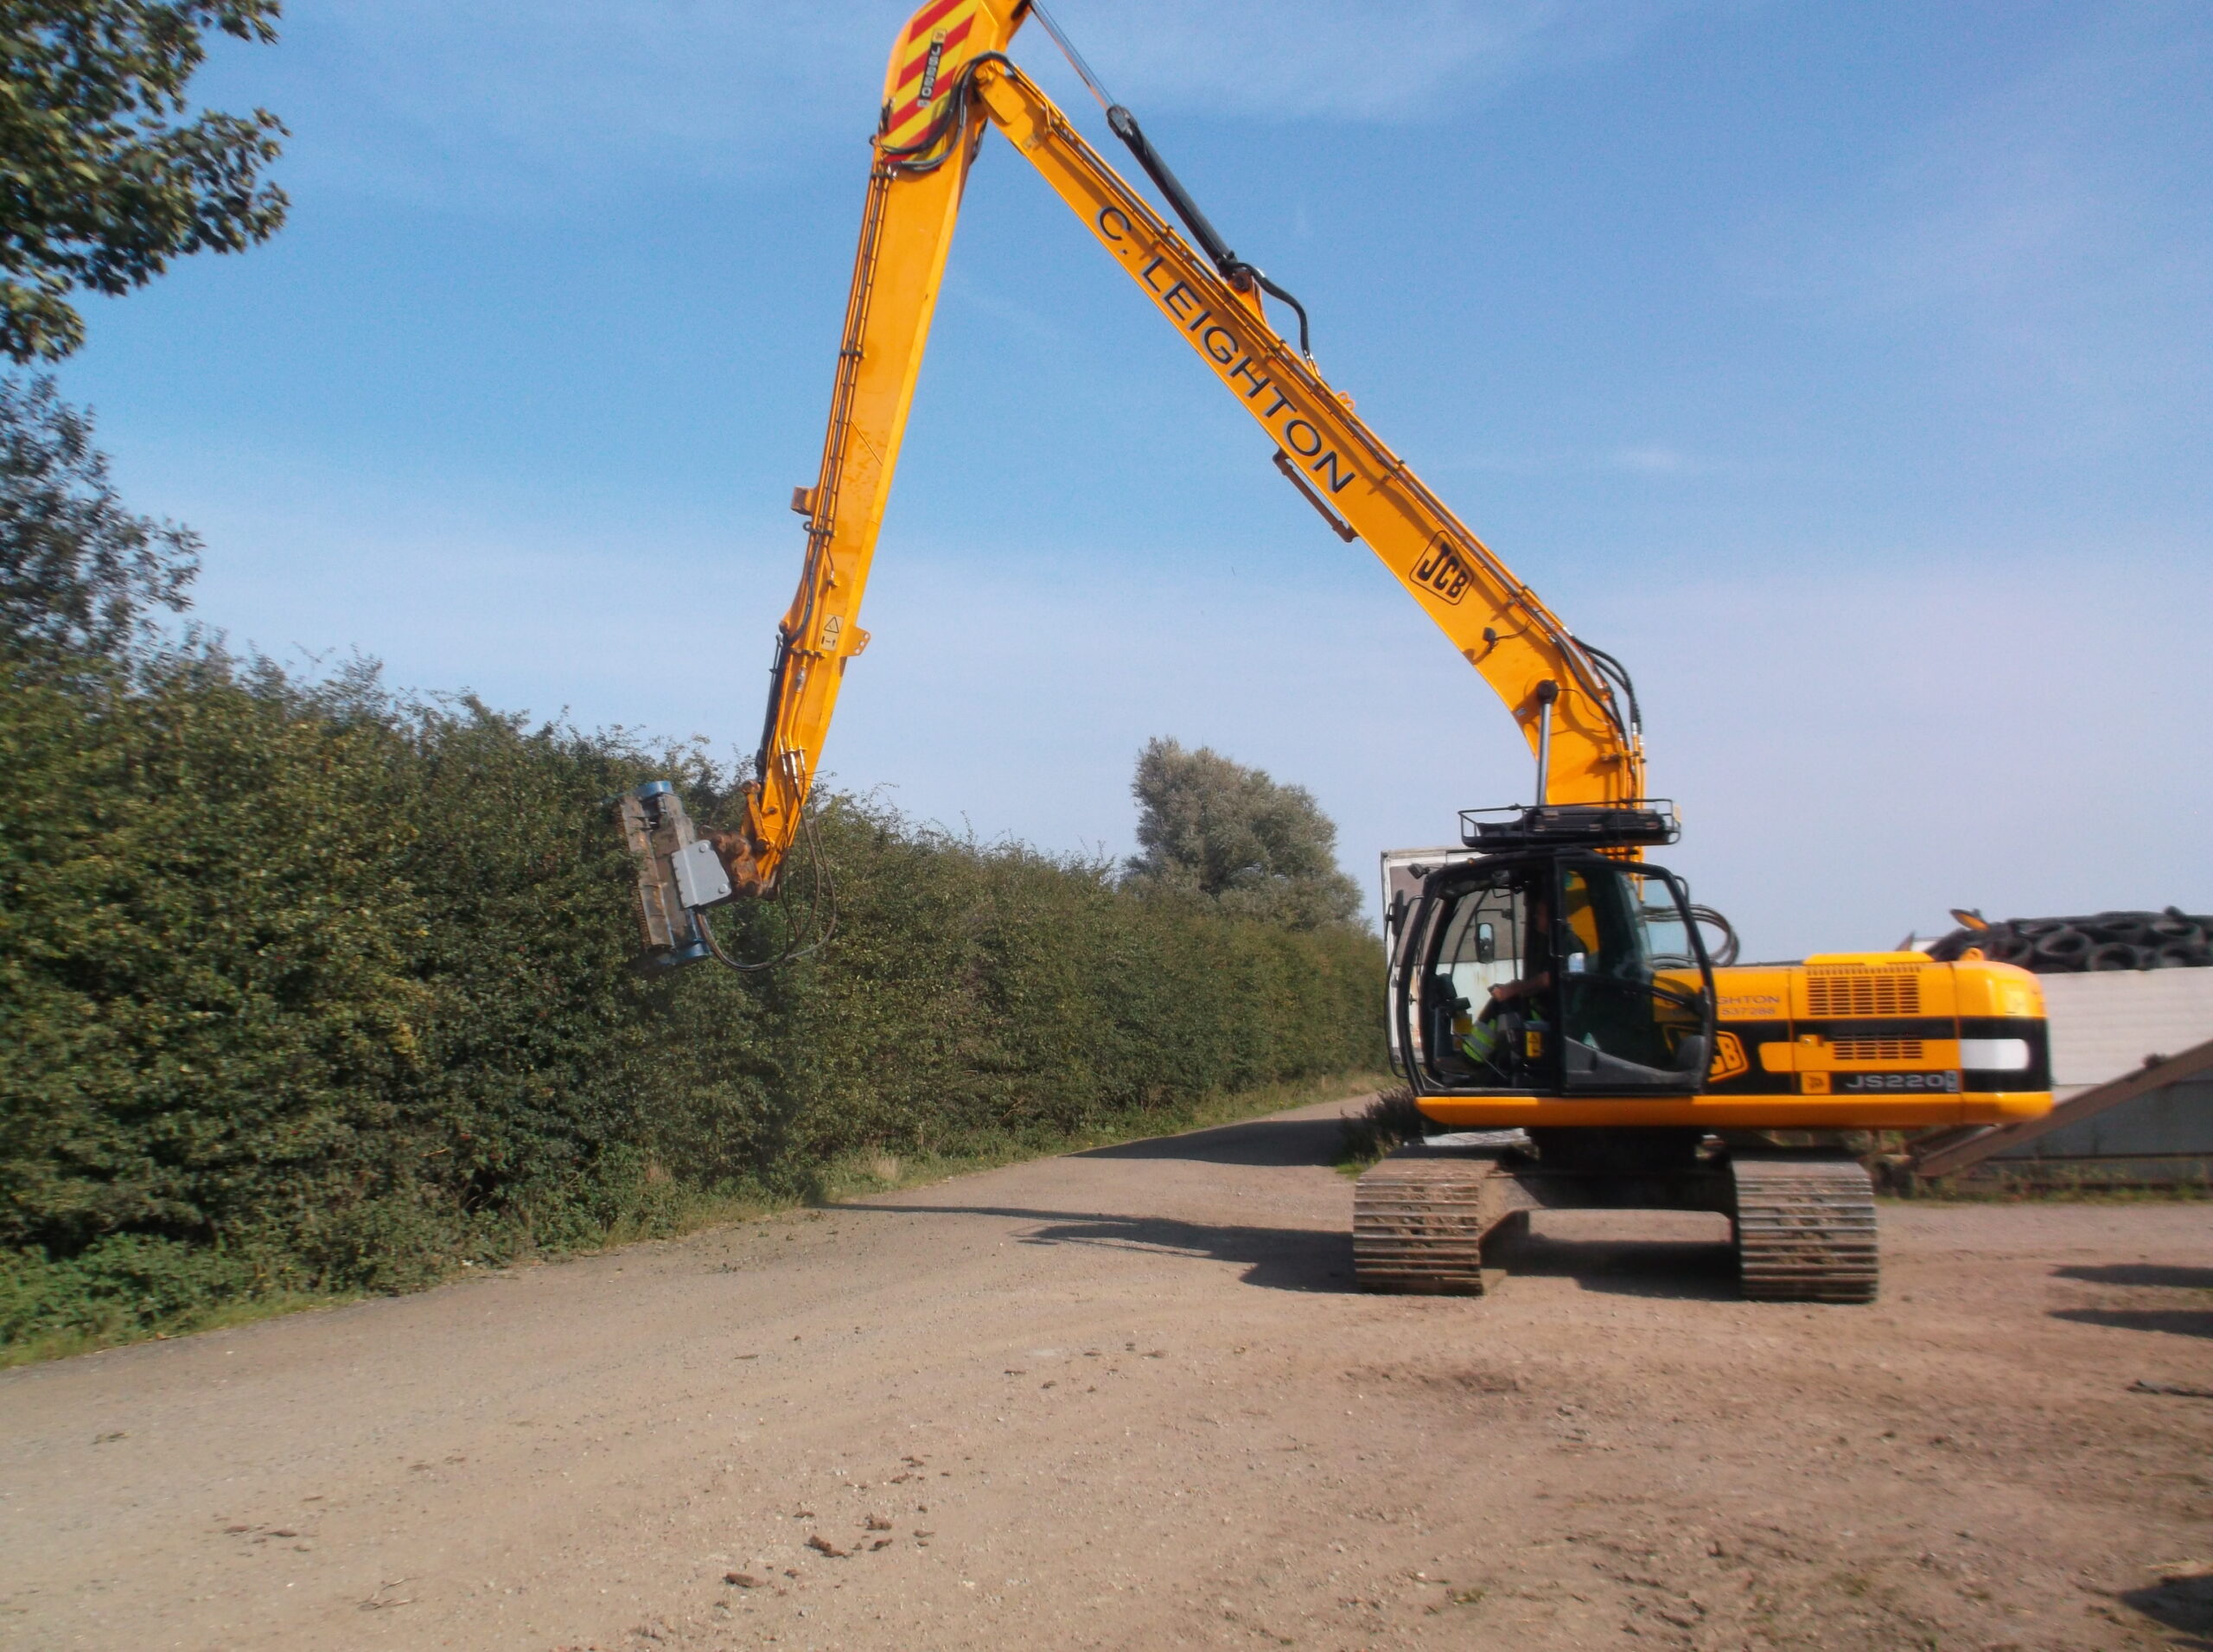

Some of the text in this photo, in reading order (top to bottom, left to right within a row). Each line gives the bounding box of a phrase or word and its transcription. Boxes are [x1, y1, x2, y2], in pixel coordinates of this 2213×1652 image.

[1140, 257, 1356, 494] LEIGHTON
[1417, 541, 1469, 598] JCB
[1846, 1075, 1944, 1088] JS220
